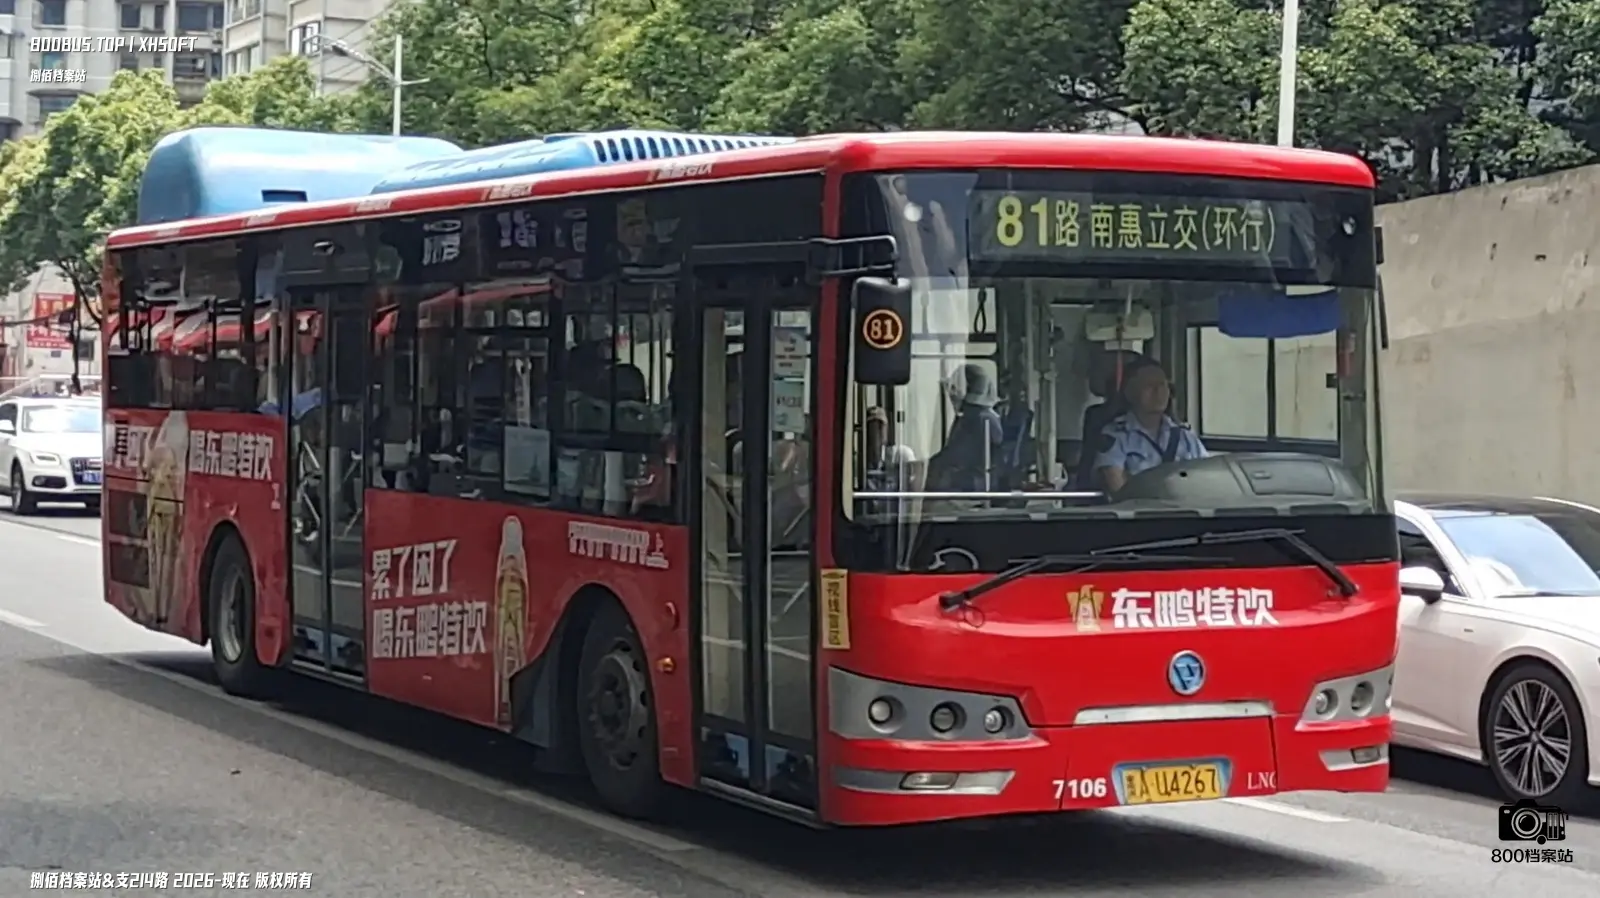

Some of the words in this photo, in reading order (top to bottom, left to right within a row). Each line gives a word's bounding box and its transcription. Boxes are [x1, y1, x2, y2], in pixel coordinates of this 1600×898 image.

[870, 319, 895, 340] 81
[371, 539, 457, 600] 累了困了
[1111, 586, 1280, 629] 东鹏特饮
[372, 600, 488, 659] 喝东鹏特饮
[1052, 776, 1108, 800] 7106
